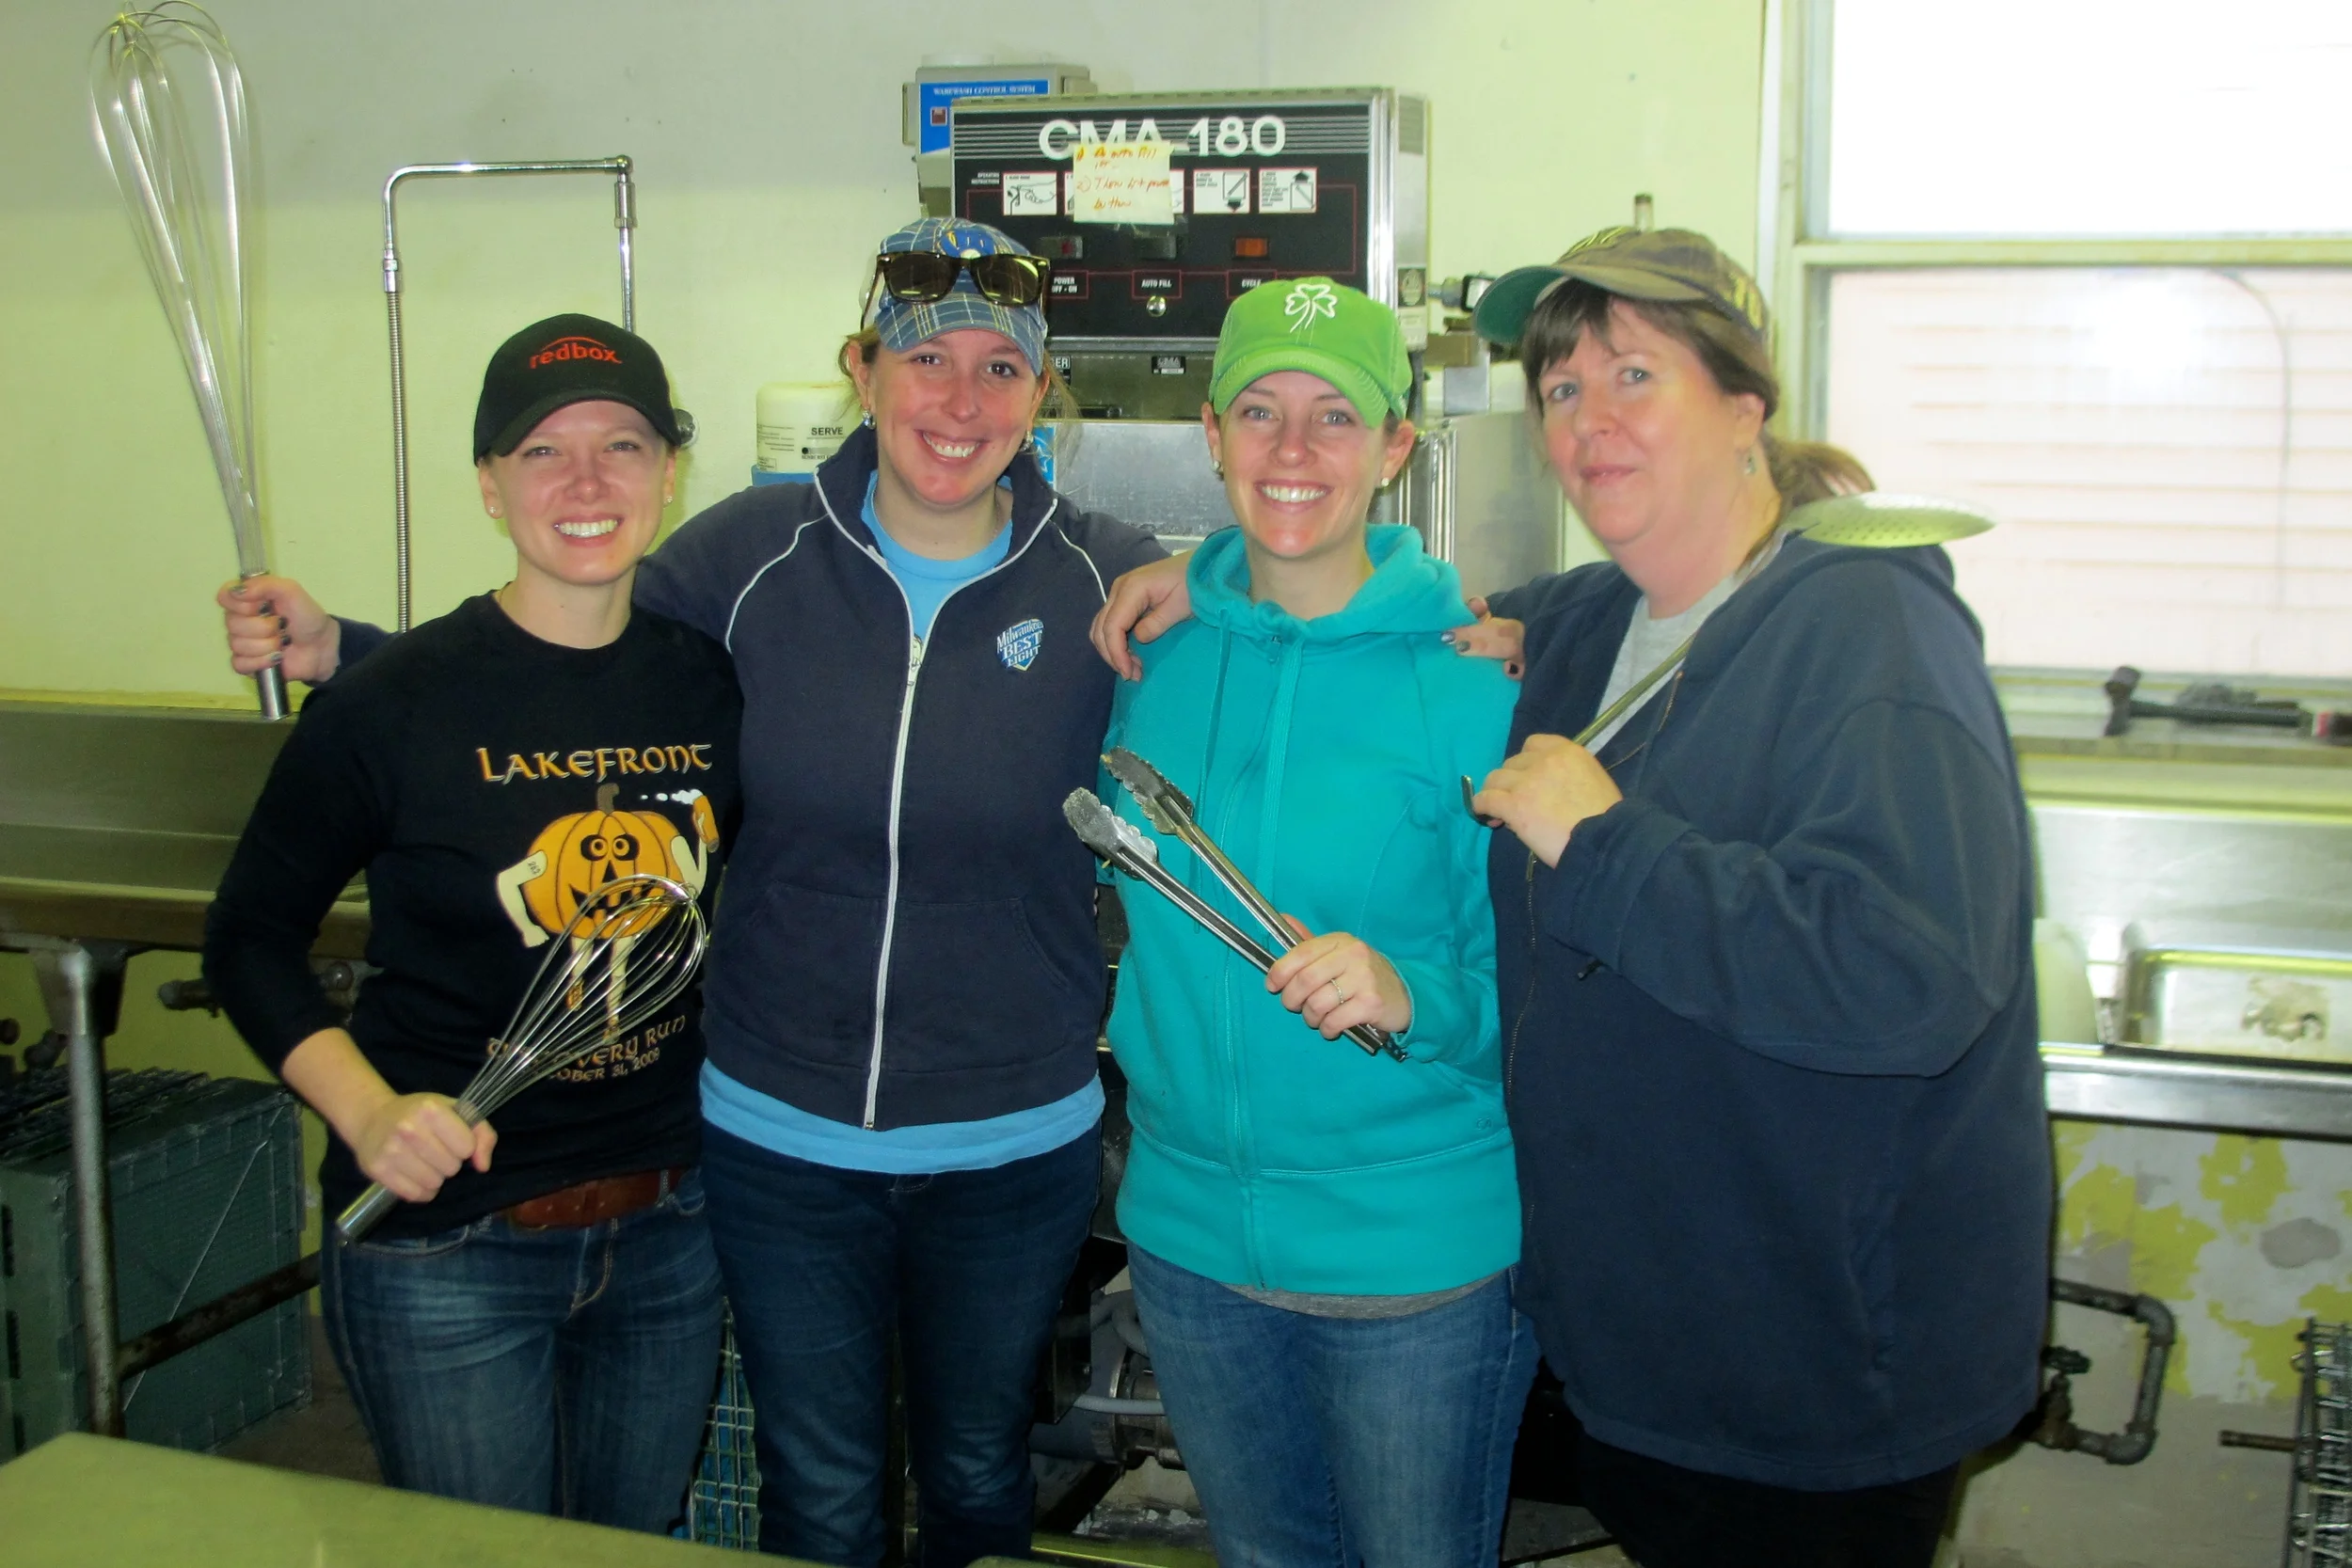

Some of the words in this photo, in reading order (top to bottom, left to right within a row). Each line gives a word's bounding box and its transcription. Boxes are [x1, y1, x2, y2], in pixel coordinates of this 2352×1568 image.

[974, 86, 1007, 94] CONTROL
[1054, 277, 1075, 285] POWER
[1141, 279, 1157, 288] AUTO
[1158, 279, 1173, 288] FILL
[529, 342, 623, 369] redbox
[811, 427, 844, 436] SERVE
[1002, 630, 1042, 662] BEST
[476, 744, 713, 785] LAKEFRONT
